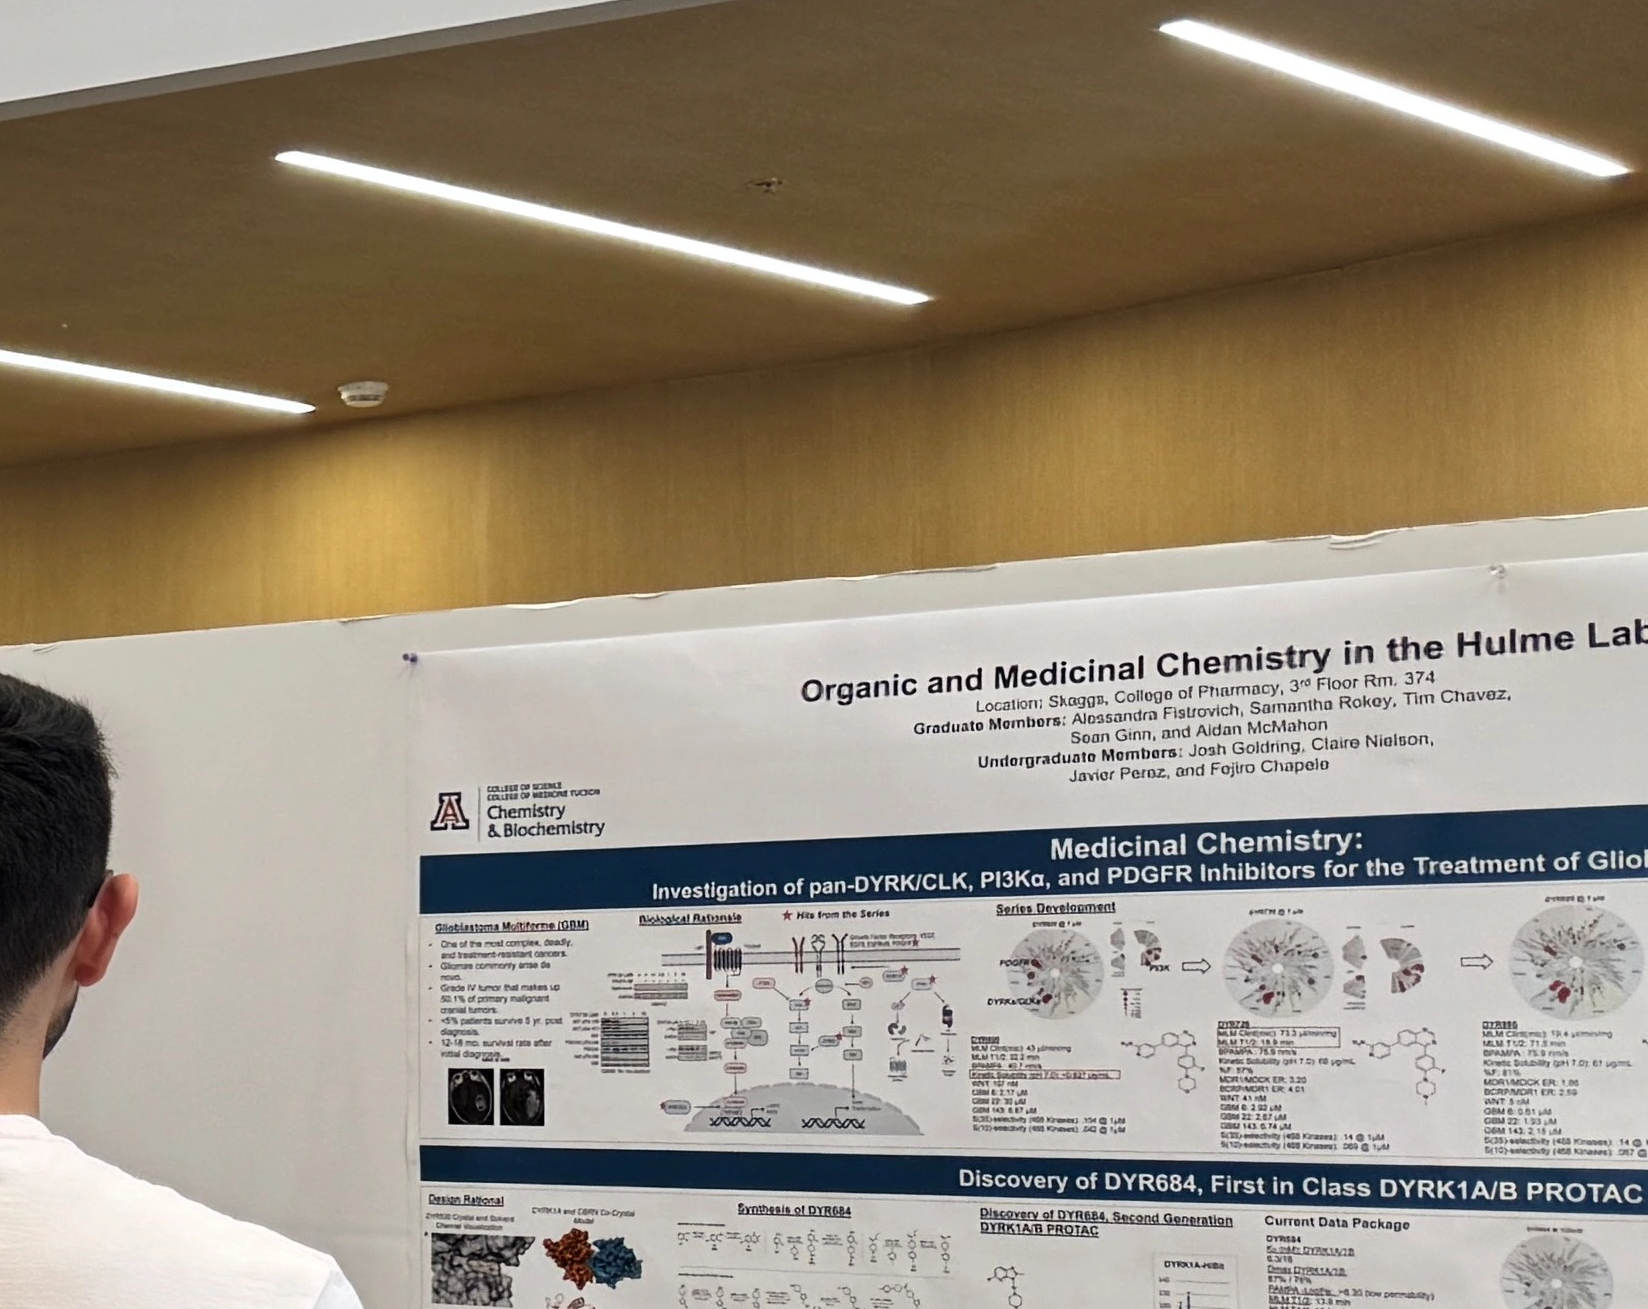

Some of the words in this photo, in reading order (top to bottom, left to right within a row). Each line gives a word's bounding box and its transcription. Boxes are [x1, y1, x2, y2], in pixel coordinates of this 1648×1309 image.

[801, 674, 917, 705] Organic
[927, 667, 982, 694] and
[994, 656, 1144, 688] Medicinal
[1156, 646, 1331, 677] Chemistry
[1344, 640, 1374, 665] in
[1386, 636, 1443, 662] the
[1457, 629, 1575, 657] Hulme
[1587, 618, 1648, 648] Lab
[976, 699, 1043, 713] Location:
[1048, 695, 1109, 709] Skaggs,
[1114, 689, 1173, 704] College
[1178, 685, 1193, 699] of
[1198, 684, 1284, 698] Pharmacy,
[1316, 677, 1359, 691] Floor
[1364, 674, 1397, 688] Rm.
[1404, 670, 1435, 685] 374
[1071, 731, 1110, 744] Sean
[1114, 728, 1156, 742] Ginn,
[1161, 725, 1191, 739] and
[1195, 723, 1242, 737] Aidan
[1247, 719, 1328, 734] McMahon
[487, 804, 566, 822] Chemistry
[488, 824, 501, 838] &
[503, 821, 605, 838] Biochemistry
[1051, 834, 1186, 859] Medicinal
[1196, 830, 1362, 855] Chemistry:
[653, 880, 777, 901] Investigation
[783, 878, 804, 895] of
[809, 872, 973, 896] pan-DYRK/CLK,
[1058, 867, 1099, 886] and
[1107, 865, 1192, 884] PDGFR
[1200, 862, 1315, 881] Inhibitors
[1324, 859, 1359, 878] for
[1366, 858, 1405, 876] the
[1413, 854, 1545, 874] Treatment
[1553, 851, 1581, 871] of
[996, 903, 1036, 916] Series
[1035, 902, 1116, 915] Development
[957, 1168, 1069, 1197] Discovery
[1075, 1172, 1097, 1190] of
[1105, 1172, 1203, 1195] DYR684,
[1211, 1175, 1265, 1194] First
[1273, 1176, 1293, 1195] in
[1302, 1177, 1371, 1197] Class
[1380, 1179, 1517, 1200] DYRK1A/B
[1527, 1182, 1643, 1203] PROTAC
[979, 1207, 1041, 1222] Discovery
[1040, 1209, 1056, 1223] of
[1055, 1209, 1112, 1224] DYR684,
[1111, 1211, 1161, 1226] Second
[1160, 1213, 1233, 1228] Generation
[1264, 1215, 1315, 1227] Current
[1318, 1216, 1348, 1228] Data
[1352, 1217, 1410, 1232] Package
